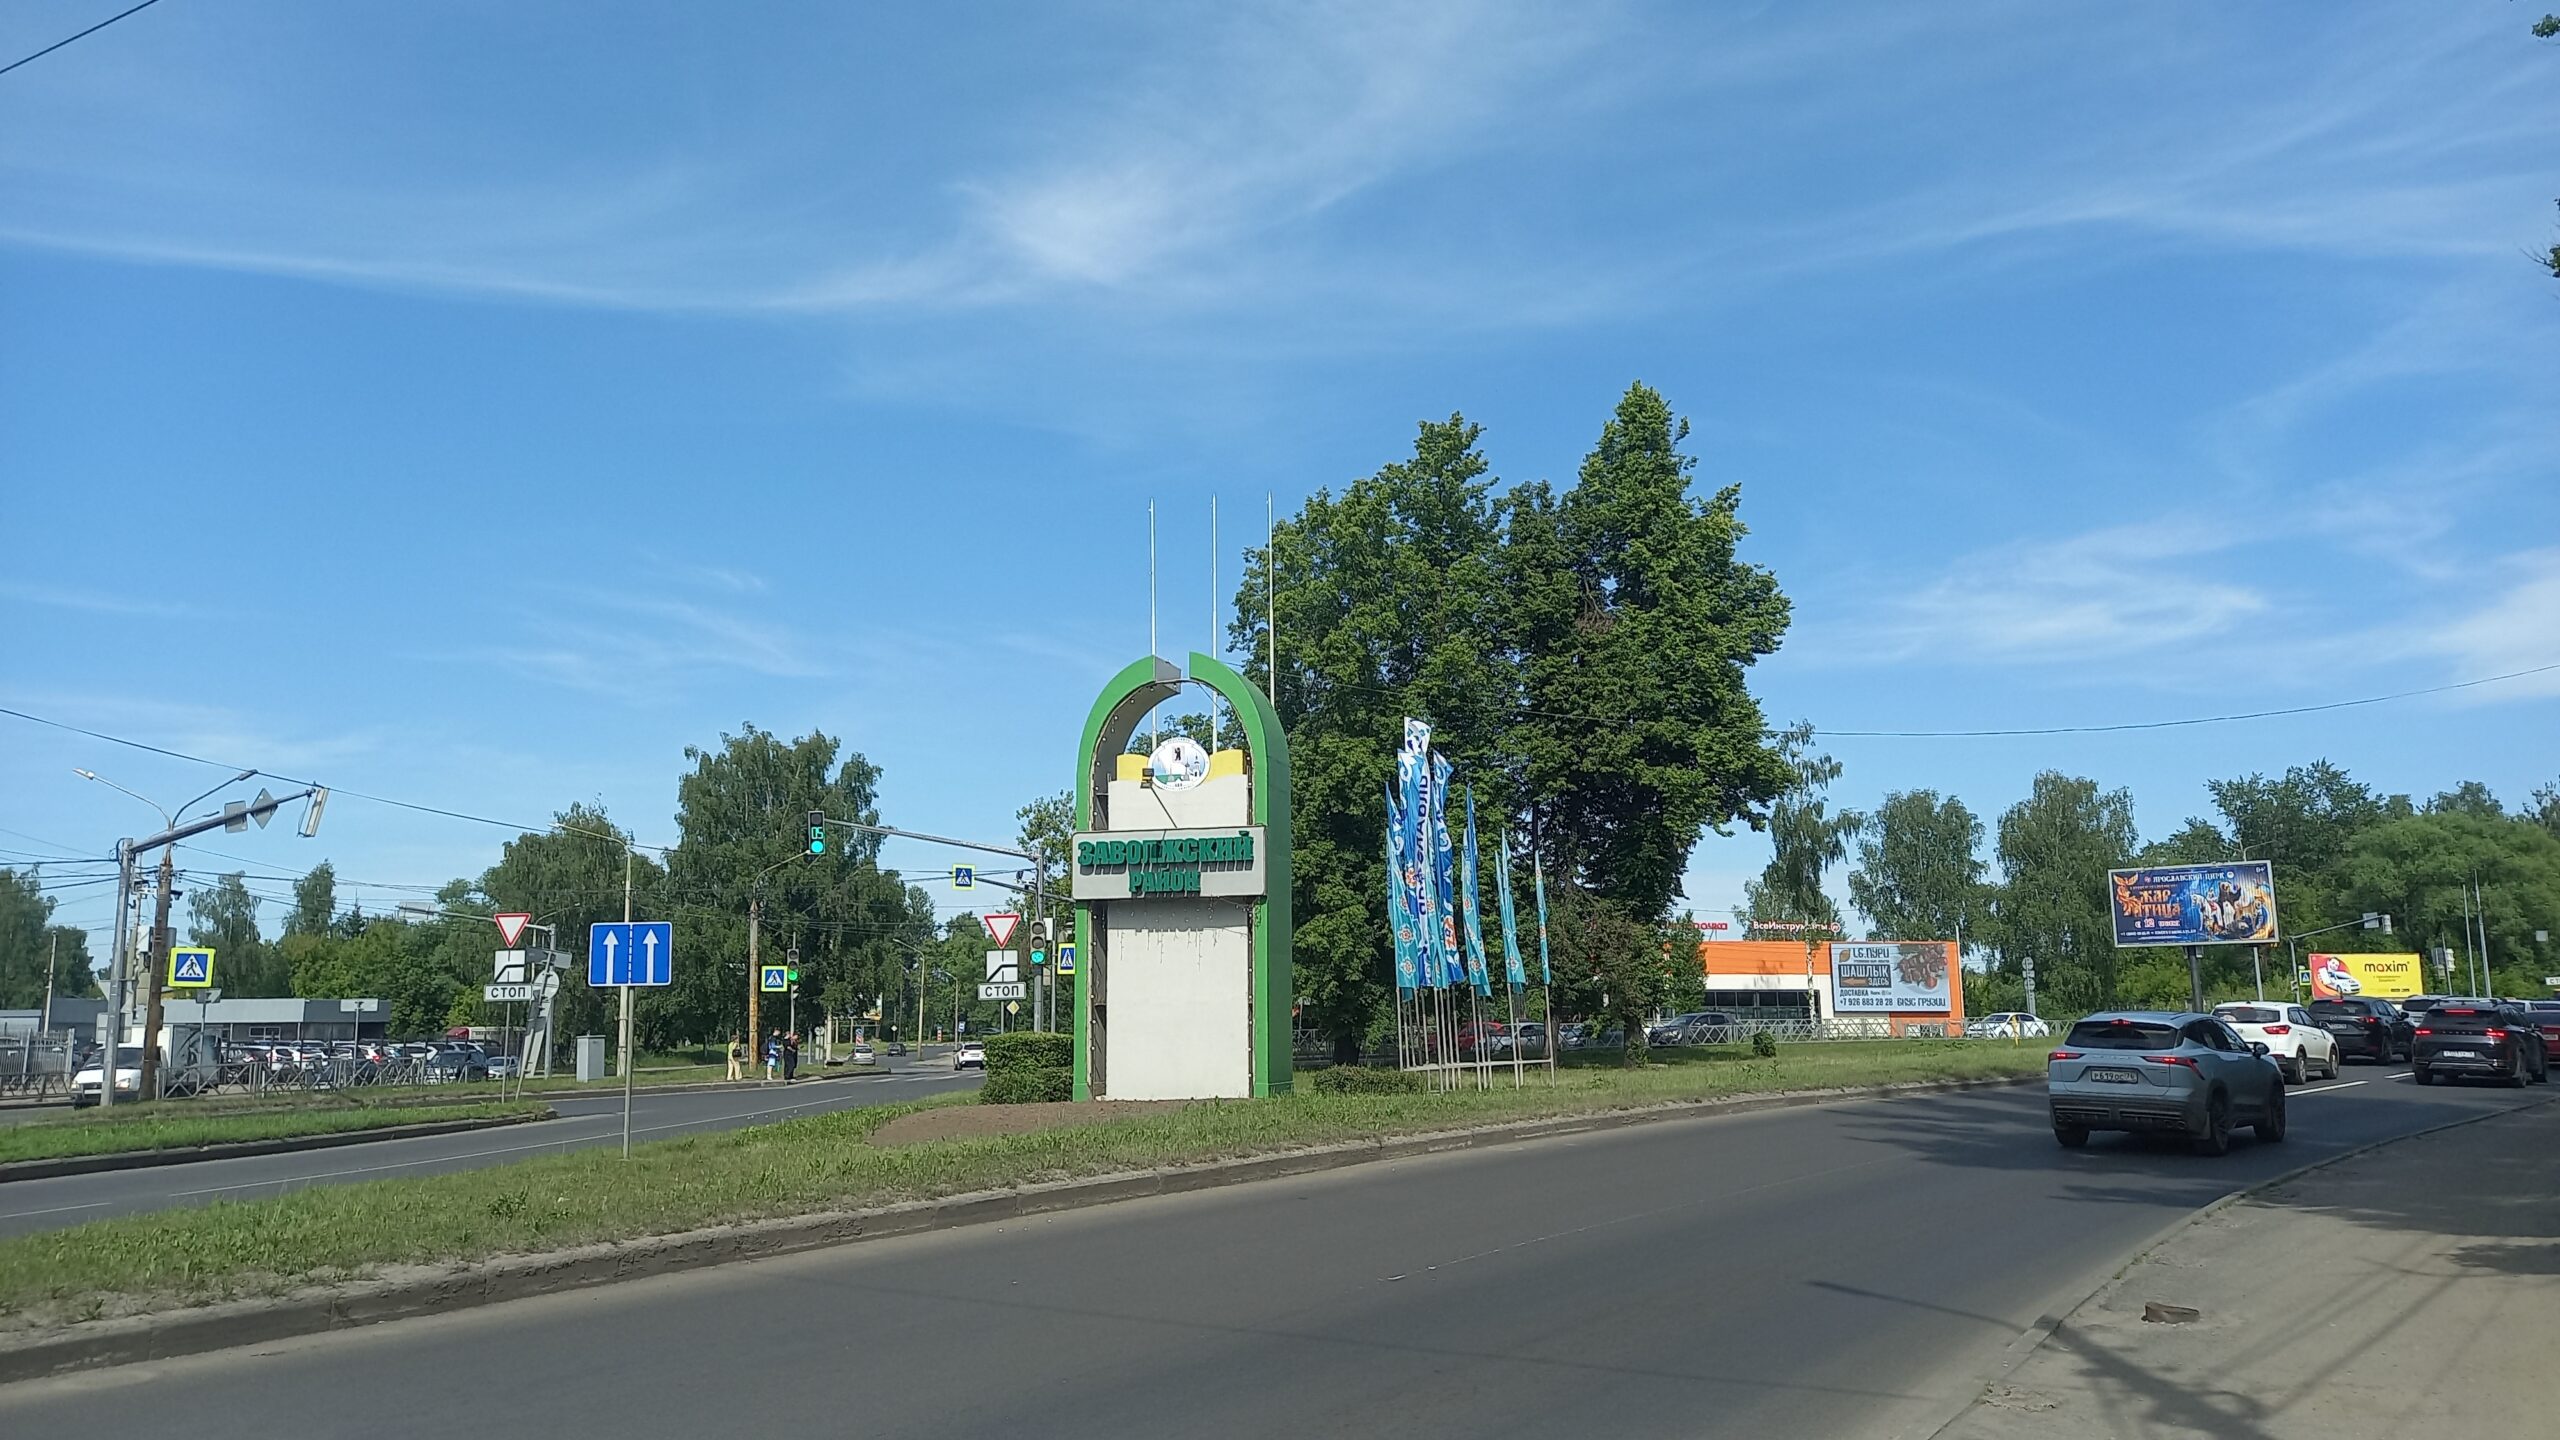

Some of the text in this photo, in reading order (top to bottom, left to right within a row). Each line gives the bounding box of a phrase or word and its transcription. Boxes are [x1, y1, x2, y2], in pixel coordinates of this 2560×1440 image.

[1078, 831, 1254, 865] ЗАВОЛЖСКИЙ
[1129, 864, 1201, 892] РАЙОН
[2153, 871, 2225, 883] ЯРОСЛАВСКИЙ ЦИРК
[1840, 965, 1889, 977] ШАШЛЫК
[2364, 960, 2408, 972] maxim
[1868, 977, 1890, 986] ЗДЕСЬ
[491, 987, 525, 998] СТОП
[985, 985, 1019, 997] СТОП
[1840, 989, 1869, 997] ДОСТАВКА
[1848, 998, 1860, 1006] 926
[1862, 998, 1874, 1006] 883
[1885, 998, 1893, 1006] 28
